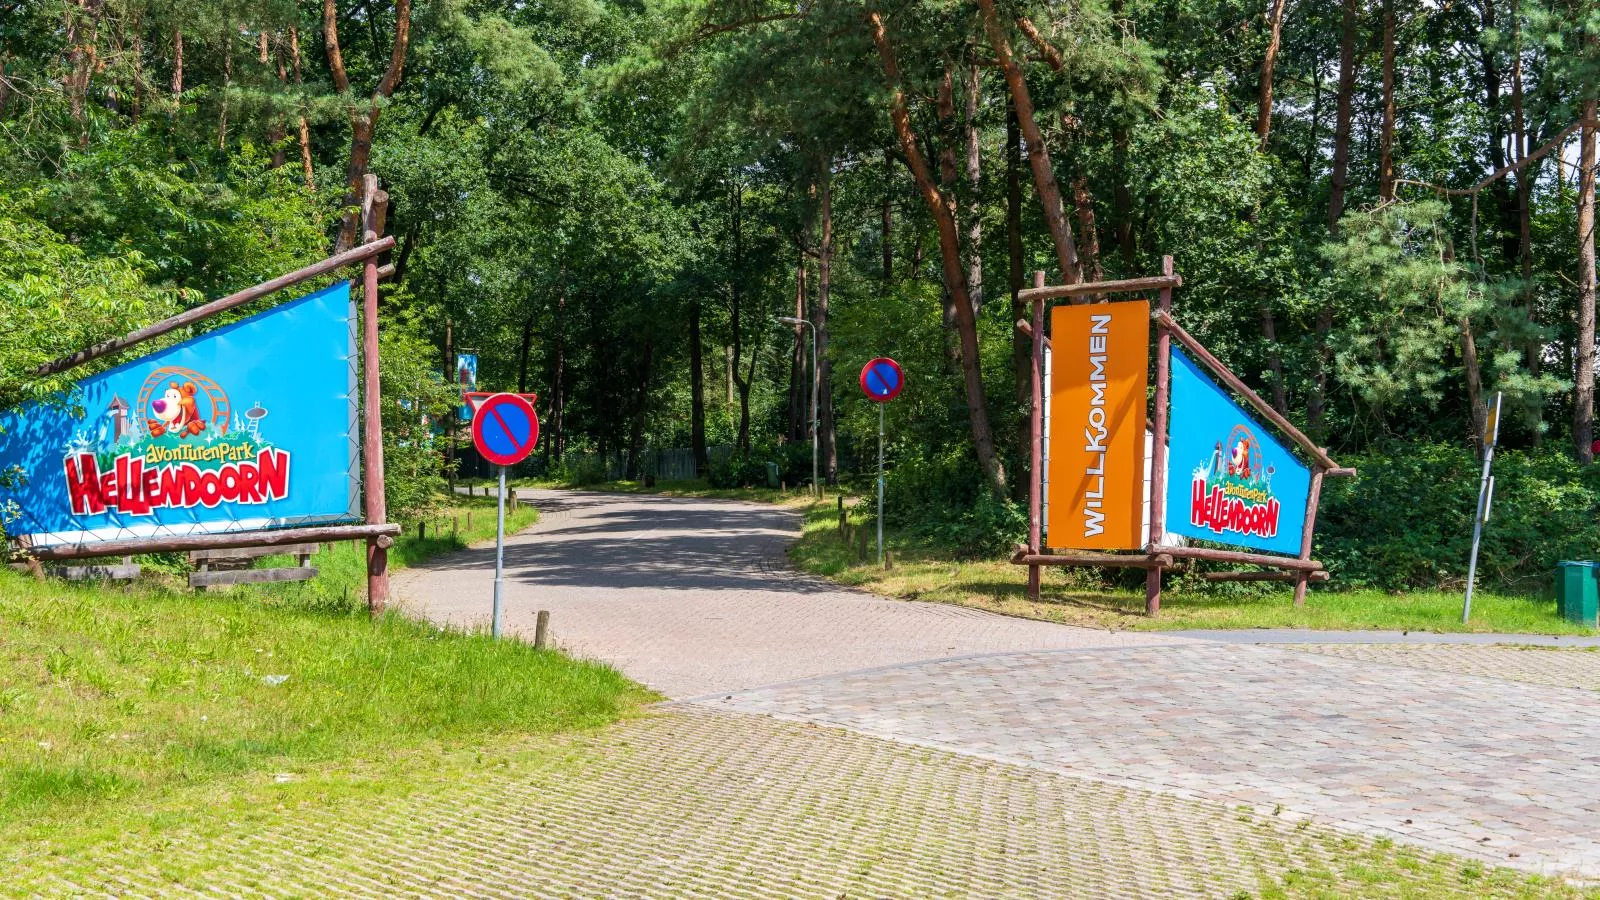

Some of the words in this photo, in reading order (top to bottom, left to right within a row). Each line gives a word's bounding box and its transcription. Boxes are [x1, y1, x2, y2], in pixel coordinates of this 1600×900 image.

[1083, 314, 1112, 538] WILLKOMMEN
[65, 448, 289, 515] HELLENDOORN
[1191, 478, 1279, 537] HELLENDOORN
